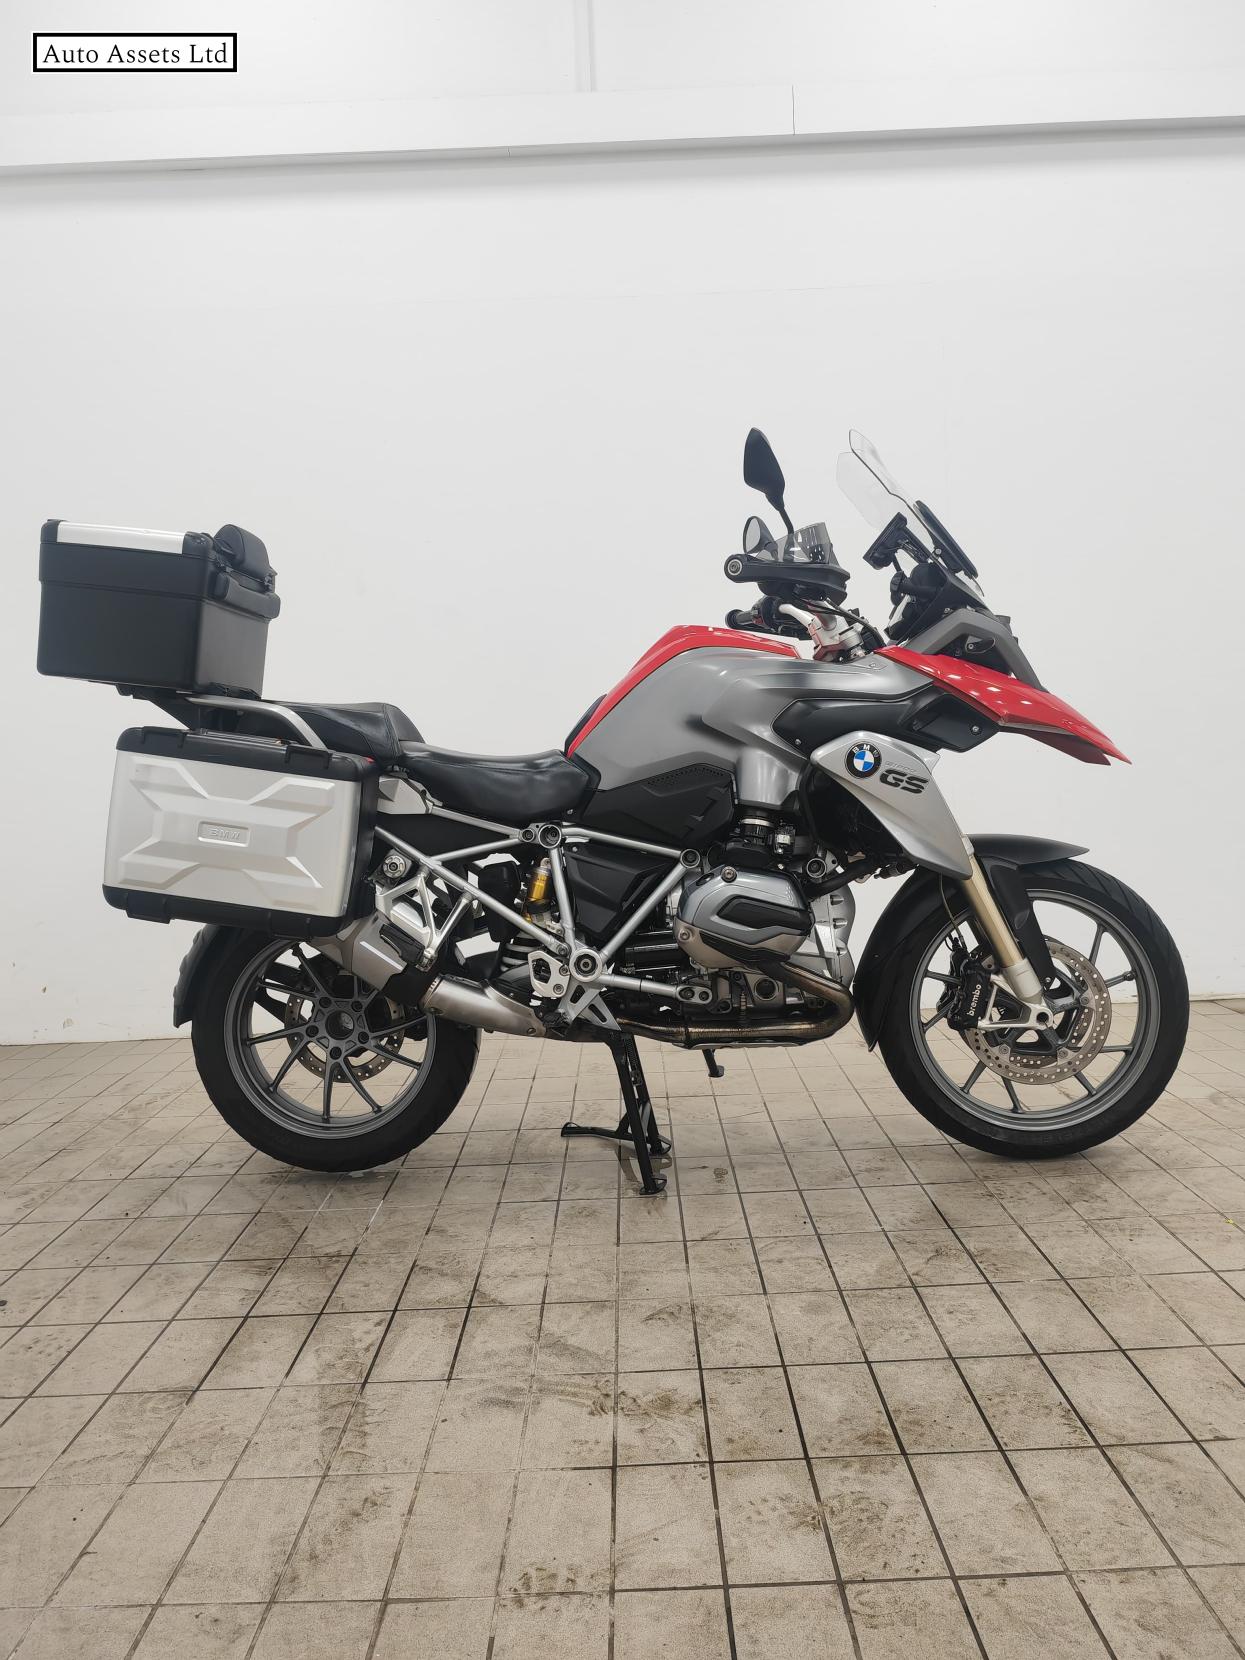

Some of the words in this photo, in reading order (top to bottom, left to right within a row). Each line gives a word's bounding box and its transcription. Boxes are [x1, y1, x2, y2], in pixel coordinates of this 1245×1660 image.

[851, 743, 880, 758] BMW
[880, 769, 929, 794] GS
[966, 984, 982, 1017] brembo
